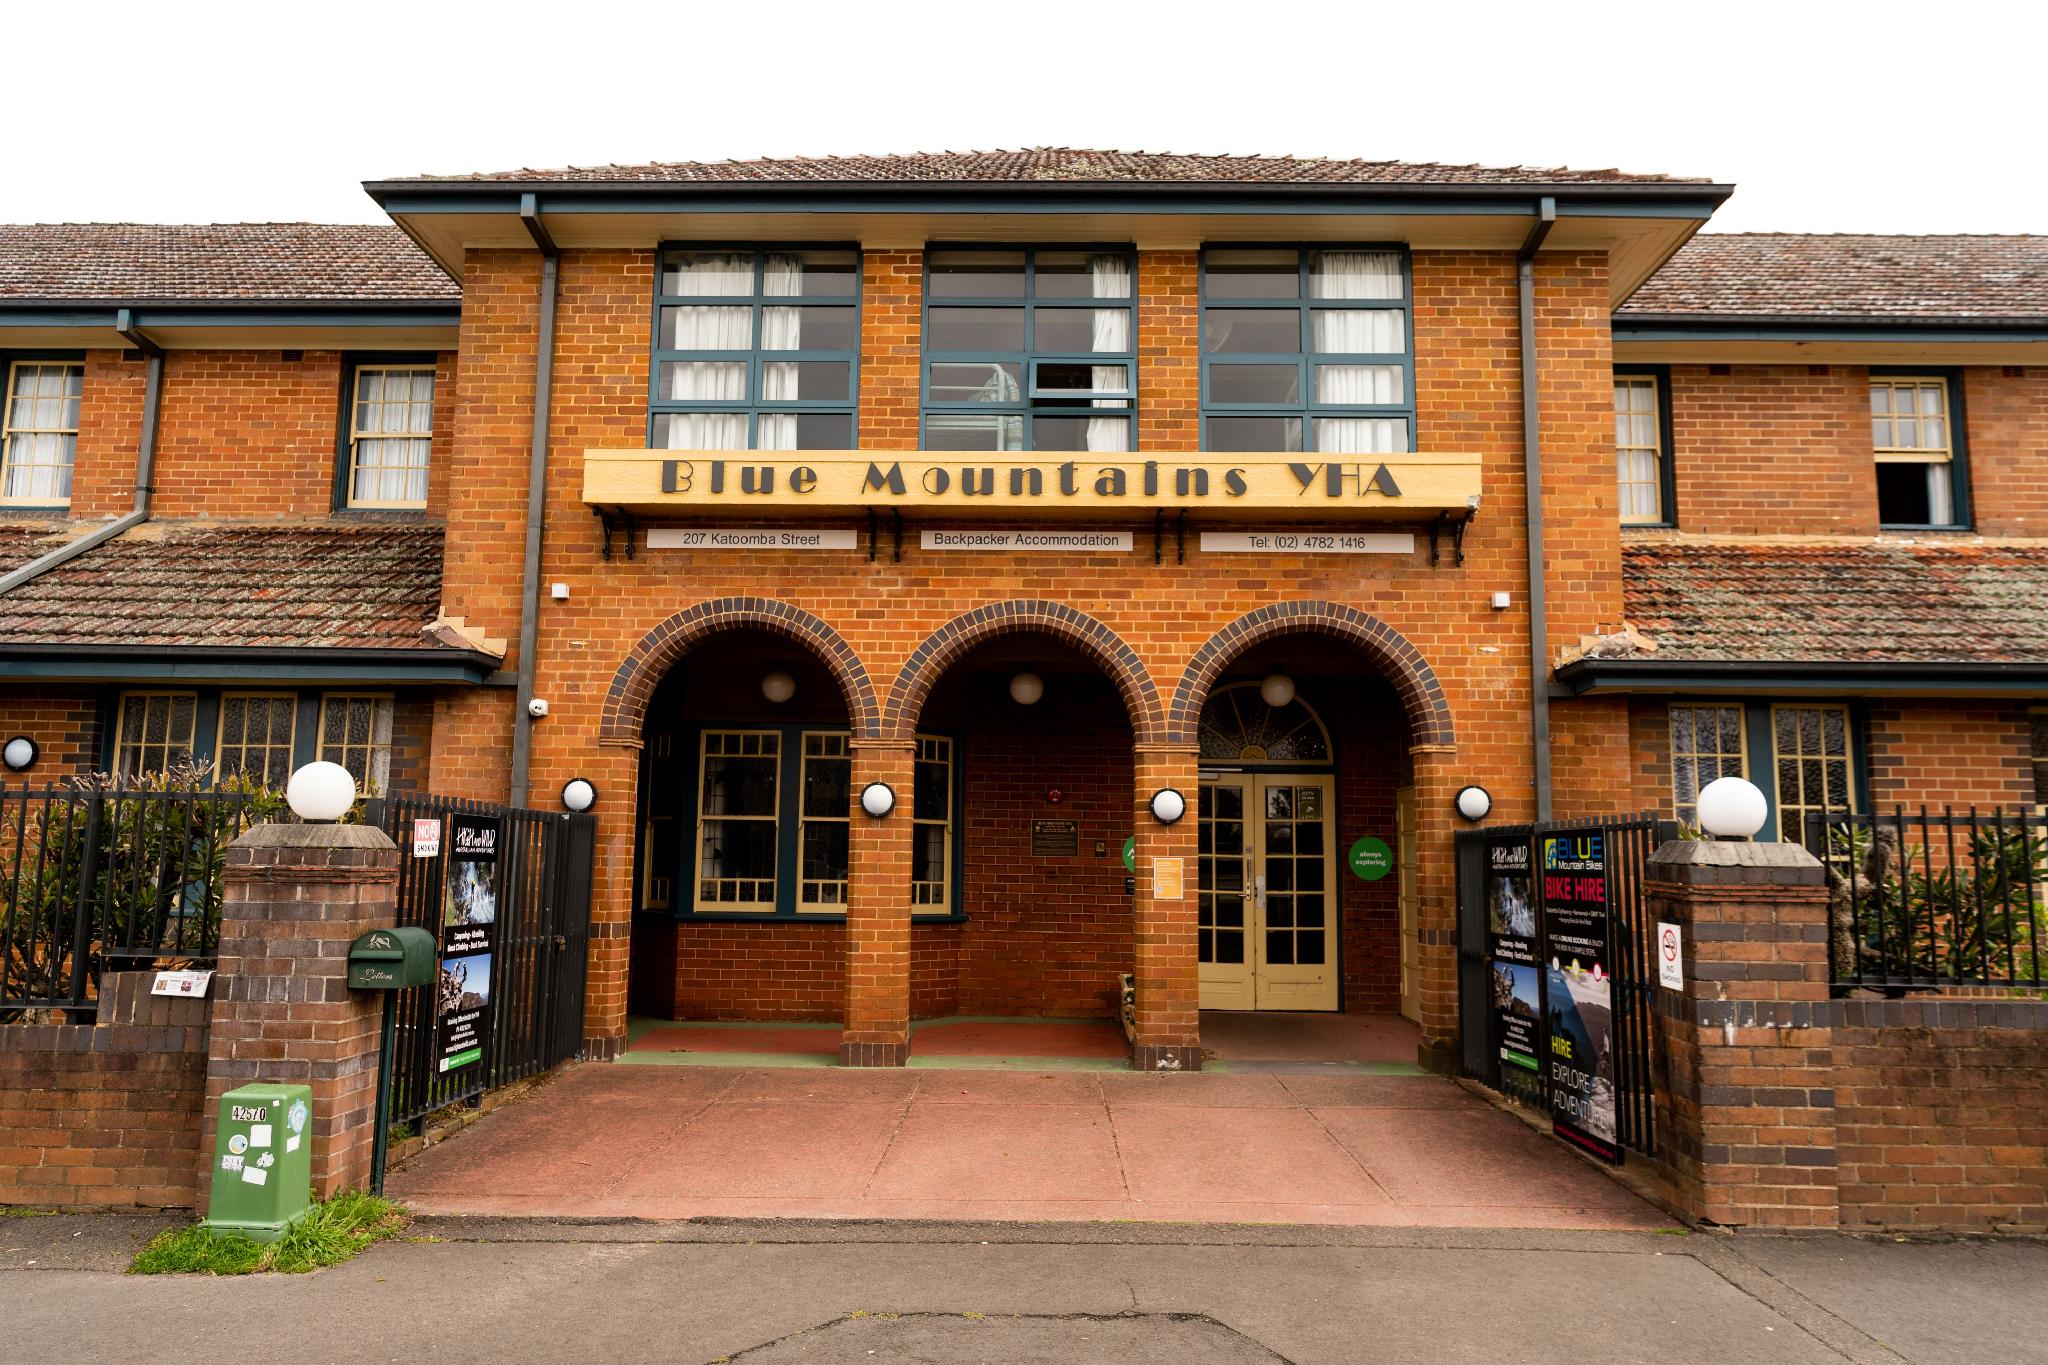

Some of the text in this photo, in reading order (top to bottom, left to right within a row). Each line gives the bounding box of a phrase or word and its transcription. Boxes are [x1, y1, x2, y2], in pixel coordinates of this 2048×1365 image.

[661, 459, 1403, 497] Blue Mountains YHA
[683, 533, 820, 545] 207 Katoomba Street
[934, 533, 1119, 547] Backpacker Accommodation
[1249, 535, 1365, 549] Tel: (02) 4782 1416
[418, 825, 430, 839] NO
[456, 827, 475, 846] HIGH
[482, 829, 496, 847] WILD
[1360, 851, 1381, 859] always
[1512, 845, 1528, 863] WILD
[1558, 837, 1603, 859] BLUE
[1356, 859, 1386, 867] exploring
[1558, 860, 1604, 870] Mountain Bikes
[1545, 877, 1605, 902] BIKE HIRE
[360, 968, 393, 981] Letters
[1666, 964, 1674, 973] NO
[1551, 1035, 1572, 1059] HIRE
[1553, 1062, 1590, 1093] EXPLORE
[233, 1106, 266, 1121] 42570
[1553, 1089, 1608, 1129] ADVENTURE
